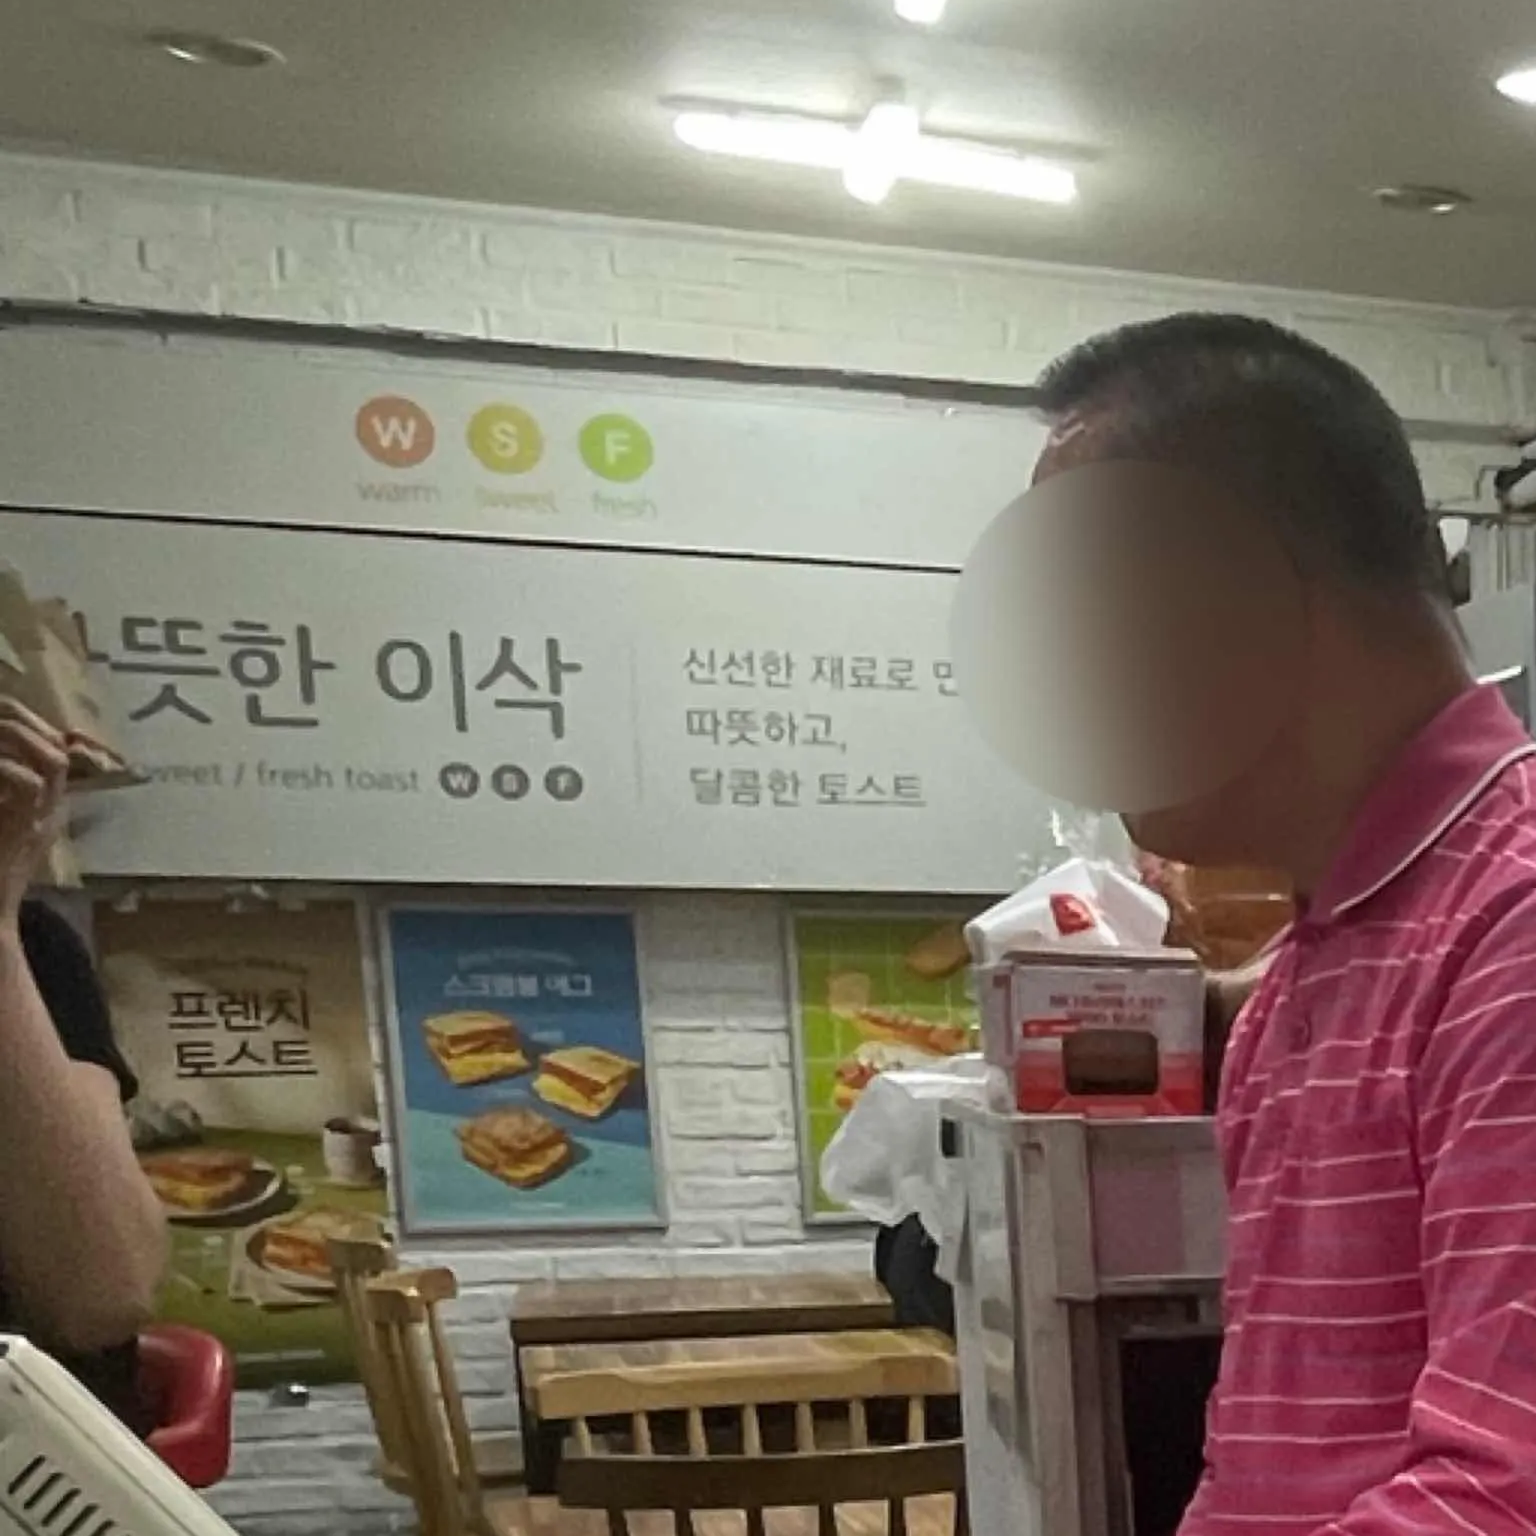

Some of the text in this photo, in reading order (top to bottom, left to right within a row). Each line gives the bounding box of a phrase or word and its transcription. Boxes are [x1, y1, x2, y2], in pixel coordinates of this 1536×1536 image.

[370, 415, 417, 452] W
[490, 421, 519, 458] S
[604, 429, 631, 465] F
[376, 629, 583, 740] 이삭
[683, 648, 796, 689] 신선한
[809, 654, 919, 691] 재료로
[686, 709, 847, 754] 따뜻하고,
[257, 760, 334, 789] fresh
[345, 767, 419, 793] toast
[689, 767, 928, 808] 달콤한 토스트
[167, 988, 310, 1033] 프렌치
[174, 1038, 319, 1079] 토스트
